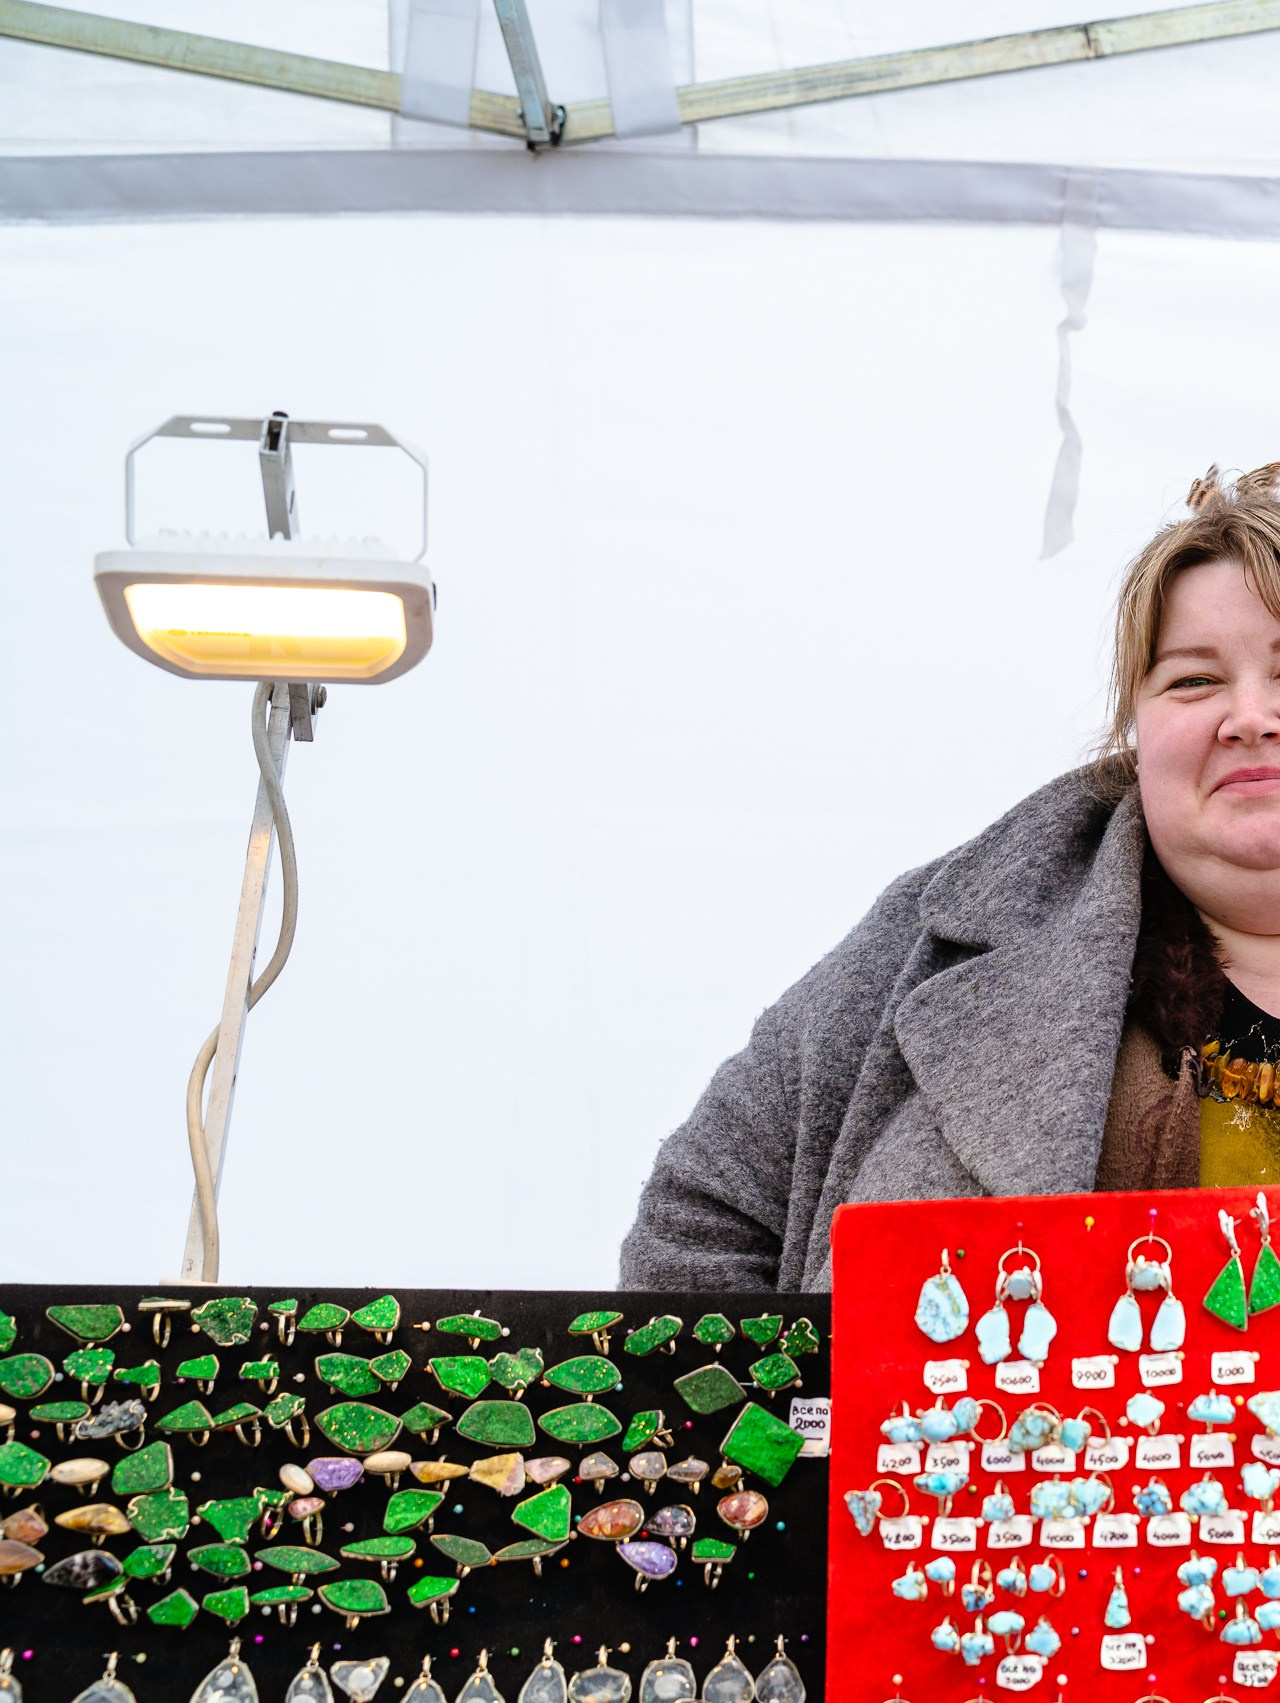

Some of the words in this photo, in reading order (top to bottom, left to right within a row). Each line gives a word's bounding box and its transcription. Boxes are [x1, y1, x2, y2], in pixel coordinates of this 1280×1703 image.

[1076, 1370, 1107, 1382] 9900
[1146, 1368, 1176, 1379] 10000
[1217, 1366, 1245, 1379] 8000
[816, 1406, 829, 1416] по
[794, 1417, 826, 1431] 2000
[882, 1457, 912, 1469] 4200
[932, 1457, 960, 1468] 3500
[1089, 1454, 1118, 1467] 4500
[1142, 1453, 1172, 1465] 4000
[940, 1534, 971, 1545] 3500
[1153, 1530, 1180, 1541] 4000
[1207, 1530, 1234, 1541] 5000
